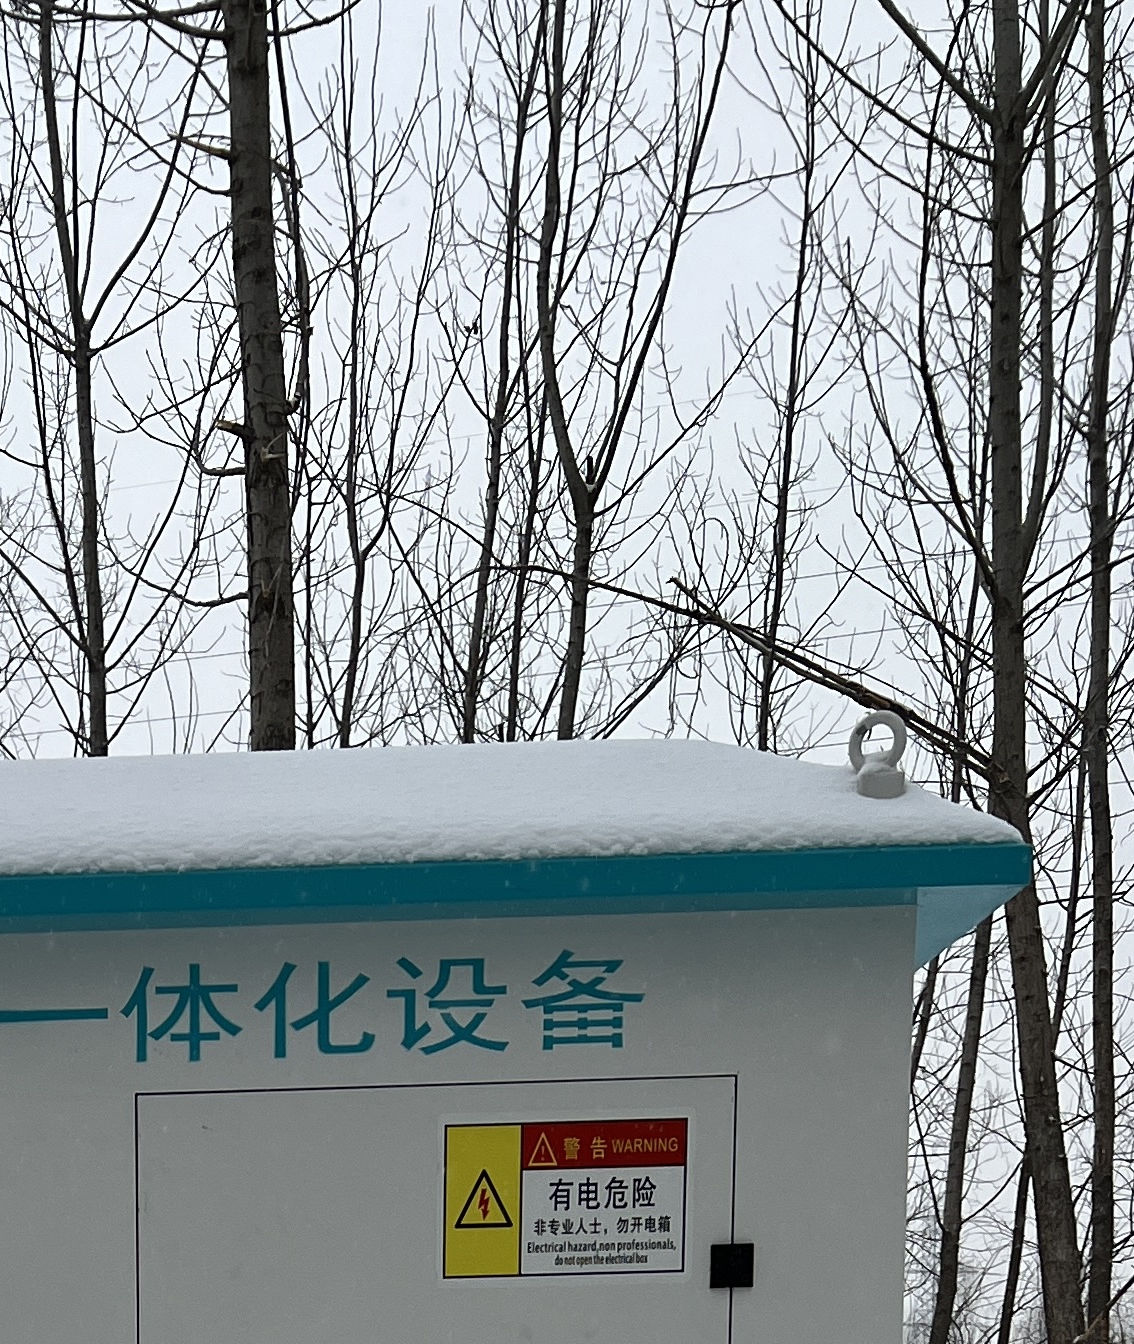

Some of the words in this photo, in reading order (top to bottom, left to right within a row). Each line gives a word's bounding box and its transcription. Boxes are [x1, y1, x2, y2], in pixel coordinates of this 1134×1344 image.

[563, 1136, 608, 1160] 警告
[611, 1137, 679, 1154] WARNING
[548, 1175, 657, 1212] 有电危险
[527, 1241, 566, 1254] Electrical
[616, 1238, 677, 1253] professionals,
[554, 1254, 564, 1266] do
[564, 1255, 576, 1266] not
[576, 1256, 593, 1268] open
[593, 1254, 605, 1265] the
[605, 1253, 635, 1265] electrical
